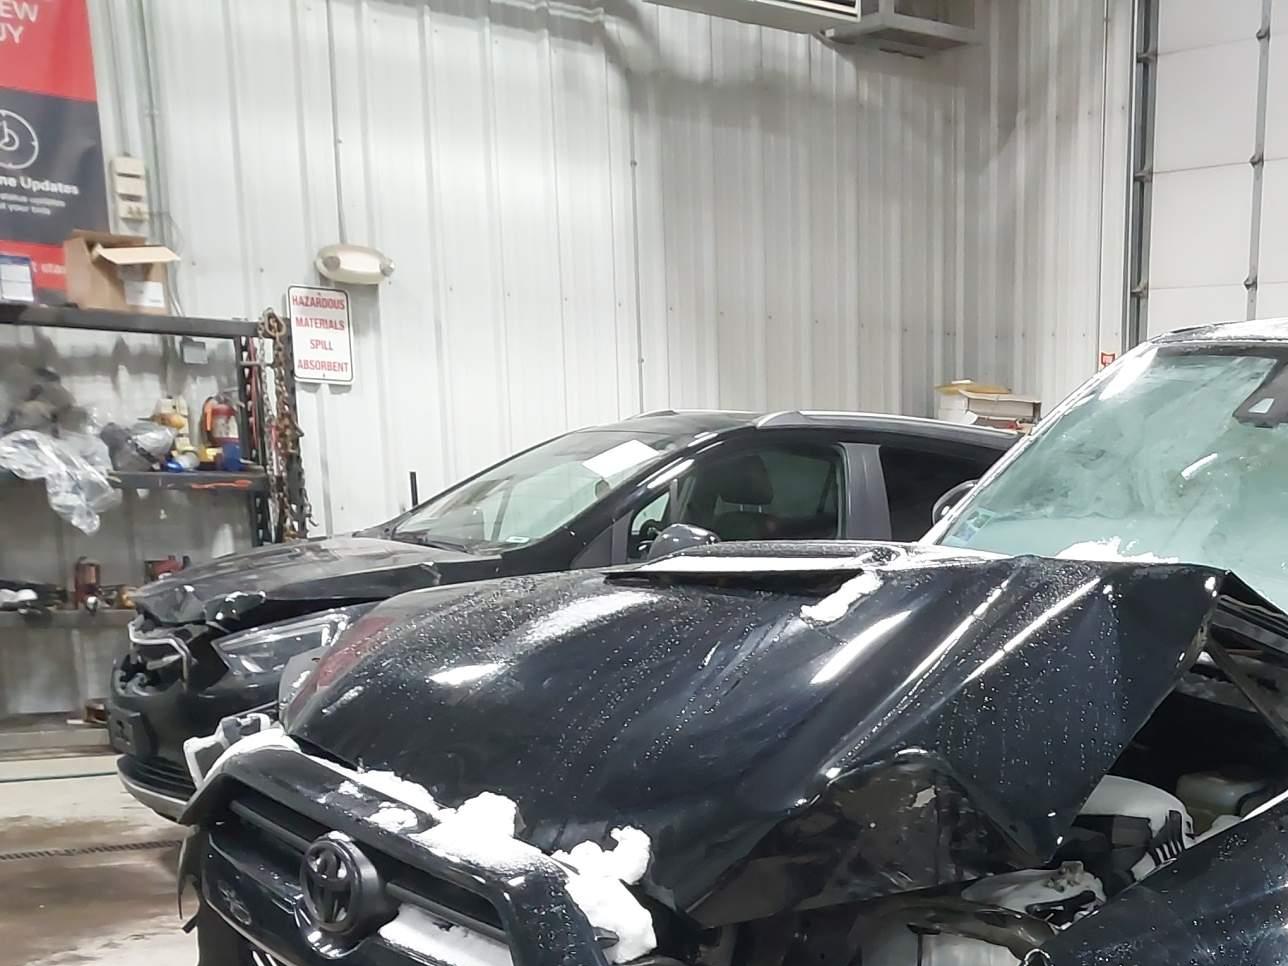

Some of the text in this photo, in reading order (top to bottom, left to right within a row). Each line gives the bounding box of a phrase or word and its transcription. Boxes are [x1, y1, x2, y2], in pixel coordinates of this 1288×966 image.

[19, 175, 79, 195] Updates
[292, 295, 346, 310] HAZARDOUS
[295, 317, 346, 331] MATERIALS
[310, 339, 334, 351] SPILL
[297, 360, 349, 372] ABSORBENT
